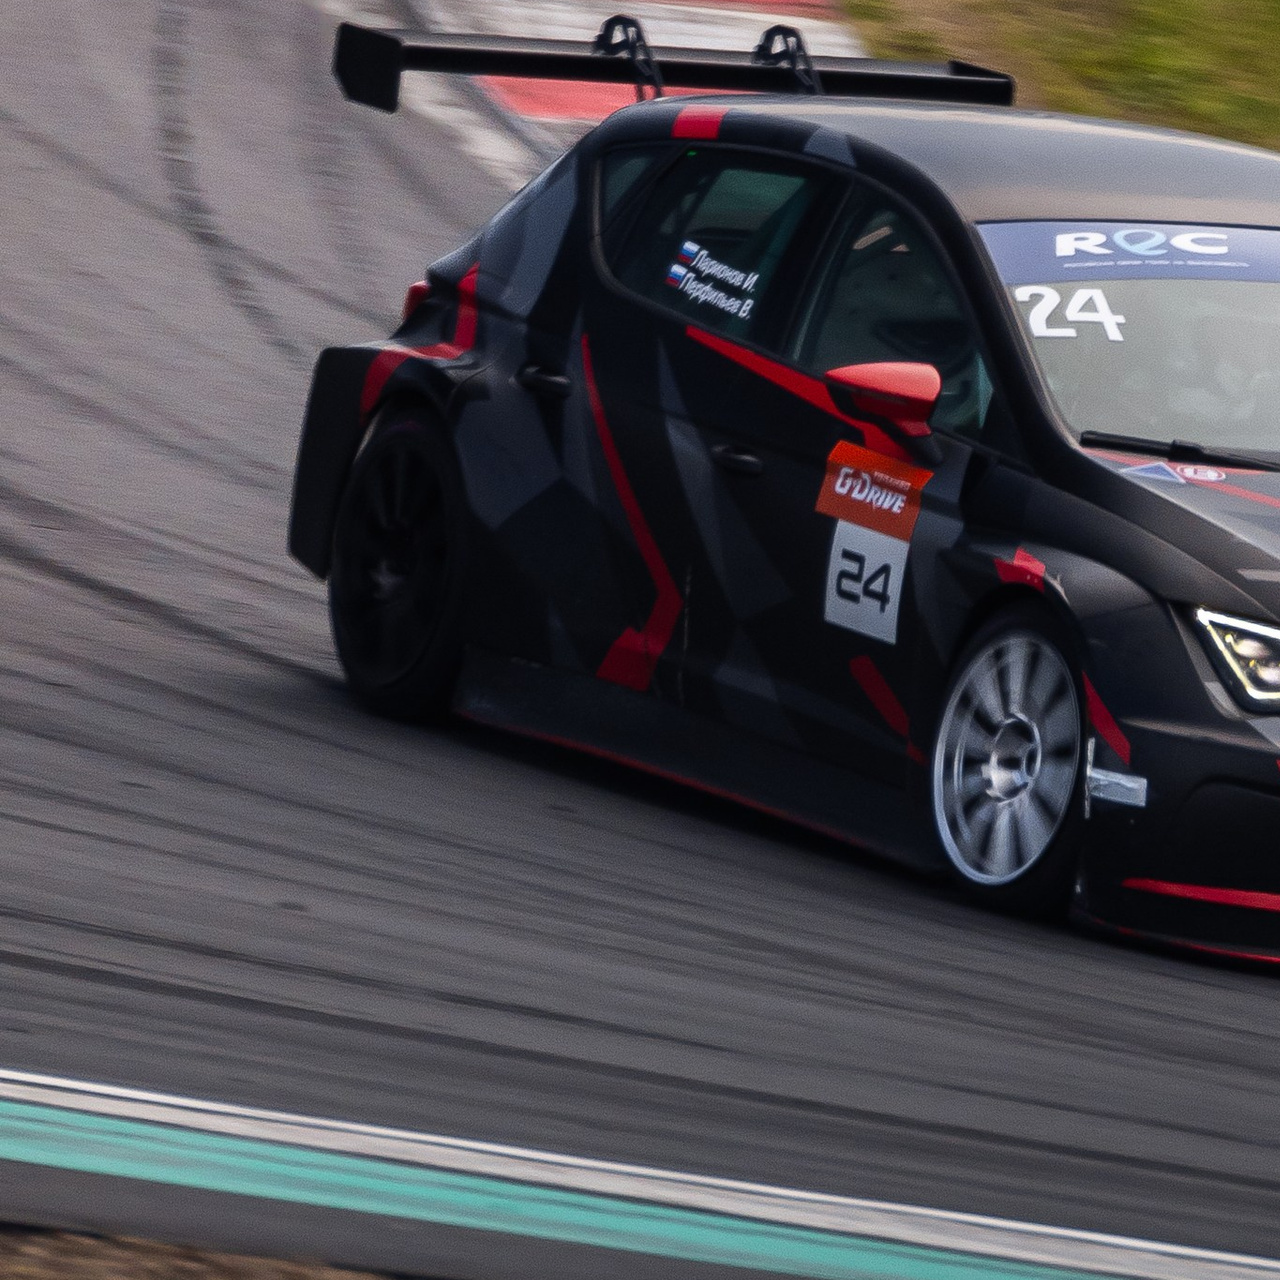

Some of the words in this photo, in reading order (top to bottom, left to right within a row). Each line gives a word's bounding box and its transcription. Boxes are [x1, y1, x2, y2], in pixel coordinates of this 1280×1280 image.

[689, 249, 747, 287] Ларионов
[1015, 285, 1126, 342] 24
[835, 548, 893, 614] 24
